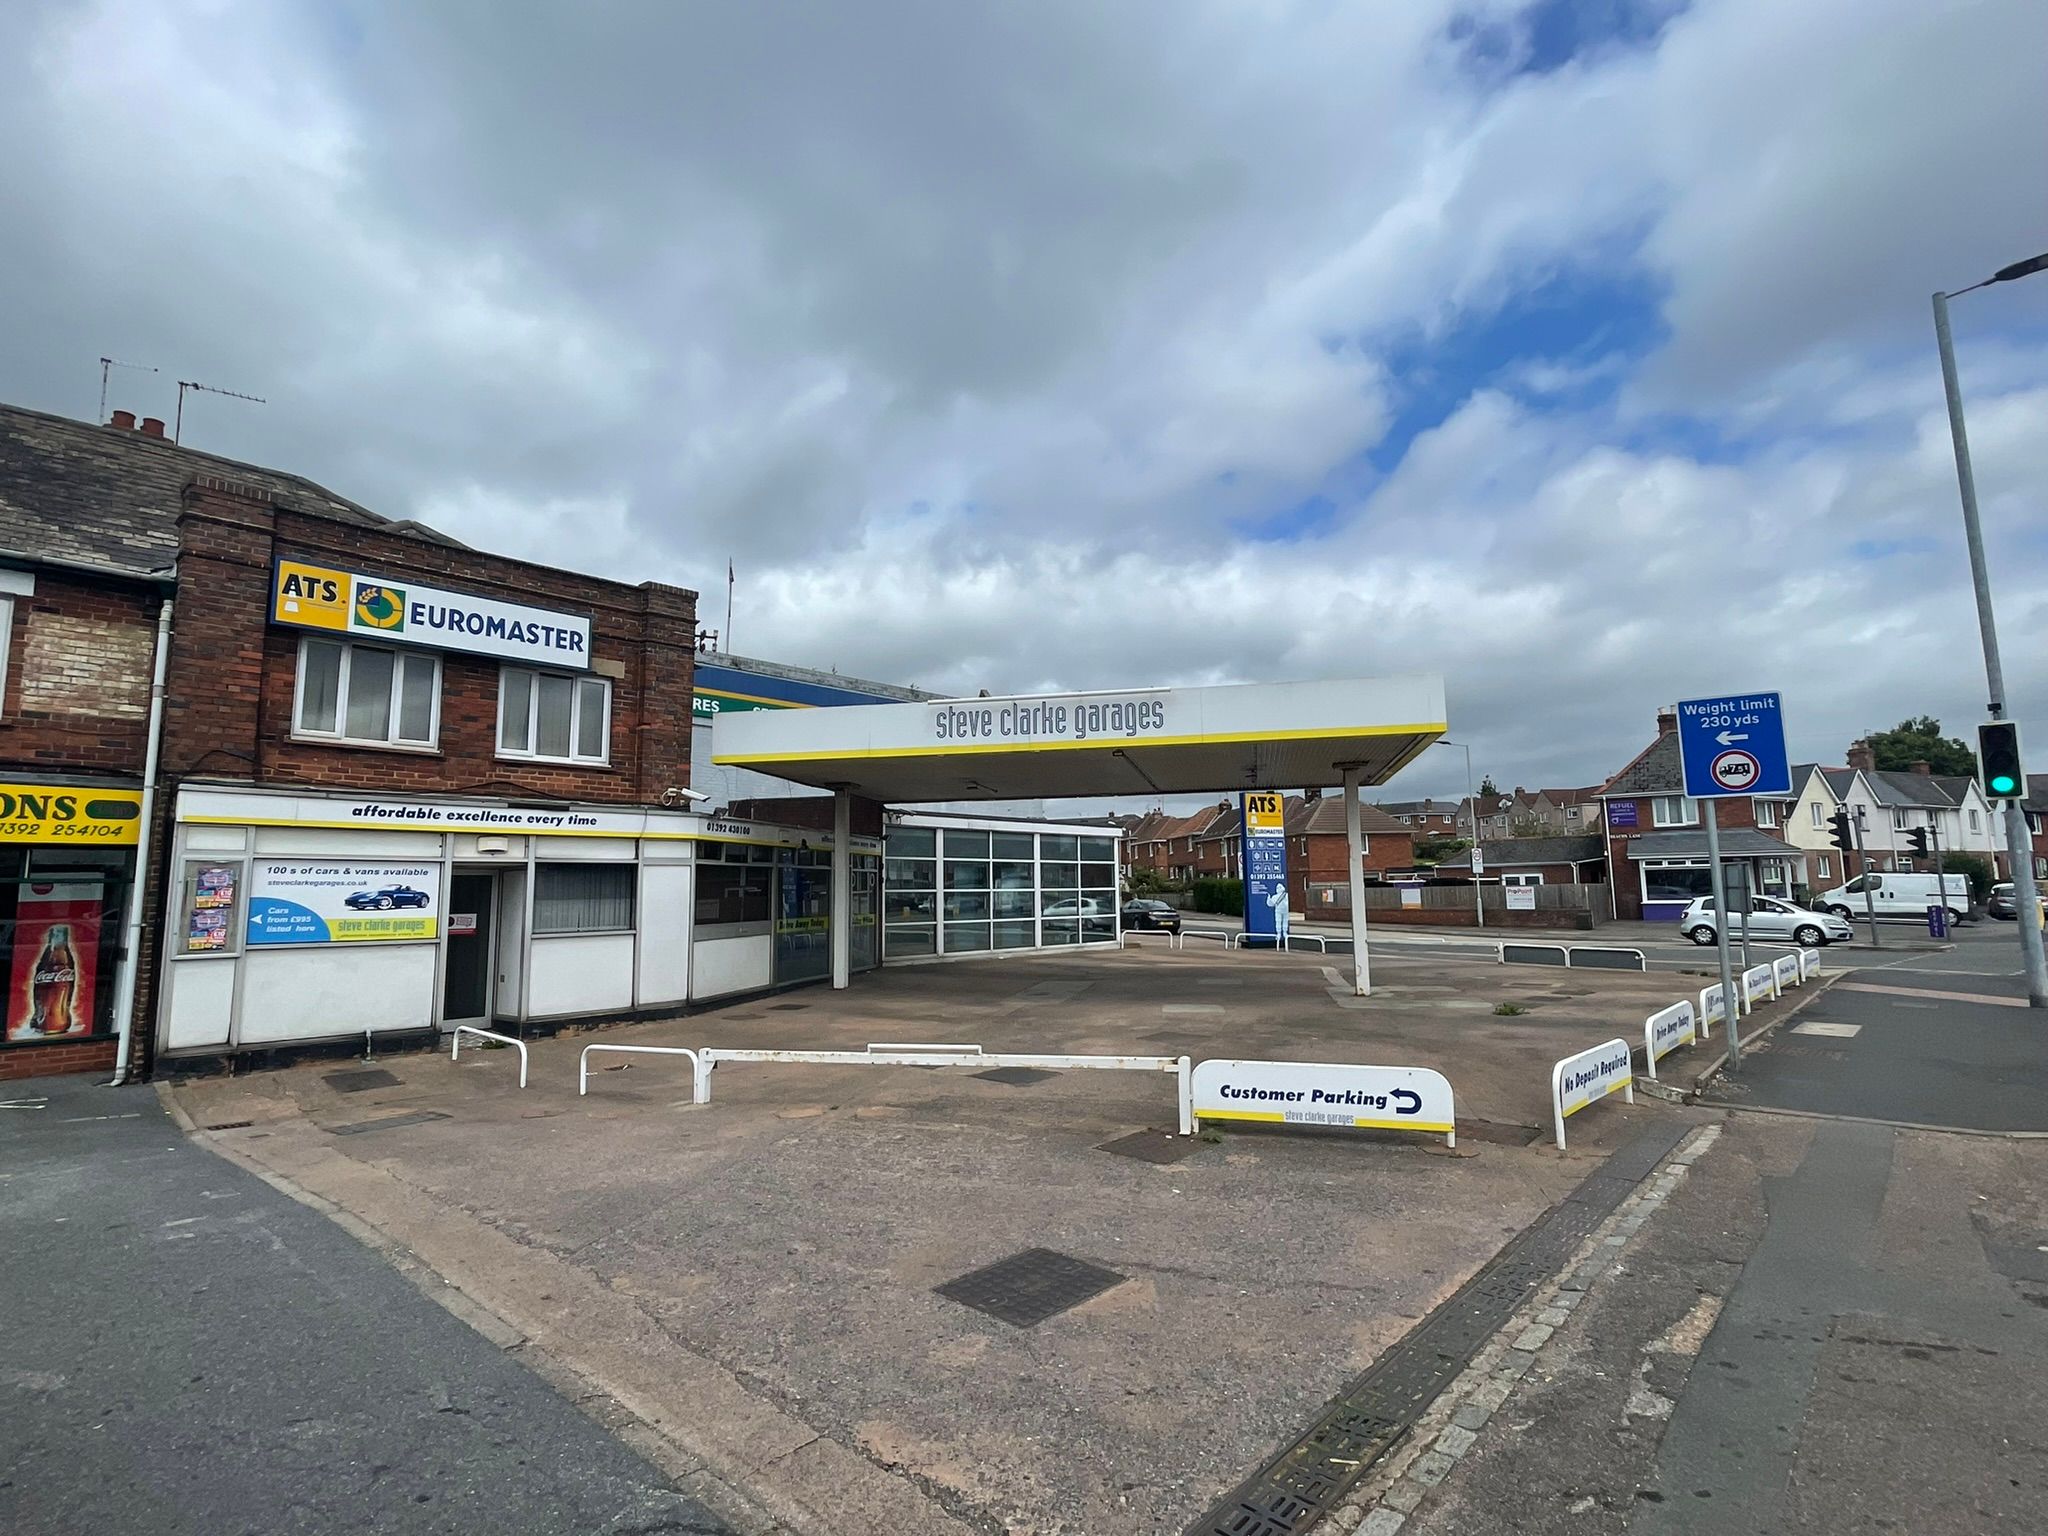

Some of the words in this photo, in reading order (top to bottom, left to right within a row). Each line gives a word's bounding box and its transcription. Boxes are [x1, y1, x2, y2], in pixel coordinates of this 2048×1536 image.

[281, 573, 337, 602] ATS
[410, 601, 584, 652] EUROMASTER
[1684, 703, 1735, 716] Weight
[1741, 698, 1775, 710] limit
[936, 706, 992, 739] steve
[1000, 701, 1067, 735] clarke
[1074, 701, 1164, 739] garages
[1701, 716, 1730, 728] 230
[1733, 714, 1760, 728] yds
[1248, 797, 1276, 813] ATS
[352, 805, 441, 820] affordable
[446, 810, 522, 823] excellence
[527, 814, 564, 827] every
[568, 814, 597, 826] time
[51, 825, 123, 836] 254104
[706, 822, 727, 833] 01392
[728, 825, 750, 835] 430100
[267, 866, 287, 874] 100
[382, 868, 429, 876] available
[267, 879, 368, 888] steveclarkegarages.co.uk
[266, 925, 291, 933] listed
[338, 920, 361, 931] steve
[364, 919, 390, 931] clarke
[393, 920, 425, 932] garages
[1565, 1076, 1574, 1094] No
[1575, 1063, 1599, 1088] Deposit
[1601, 1050, 1628, 1077] Required
[1220, 1084, 1304, 1103] Customer
[1311, 1089, 1388, 1110] Parking
[1285, 1110, 1303, 1121] steve
[1305, 1112, 1325, 1122] clarke
[1327, 1113, 1354, 1126] garages
